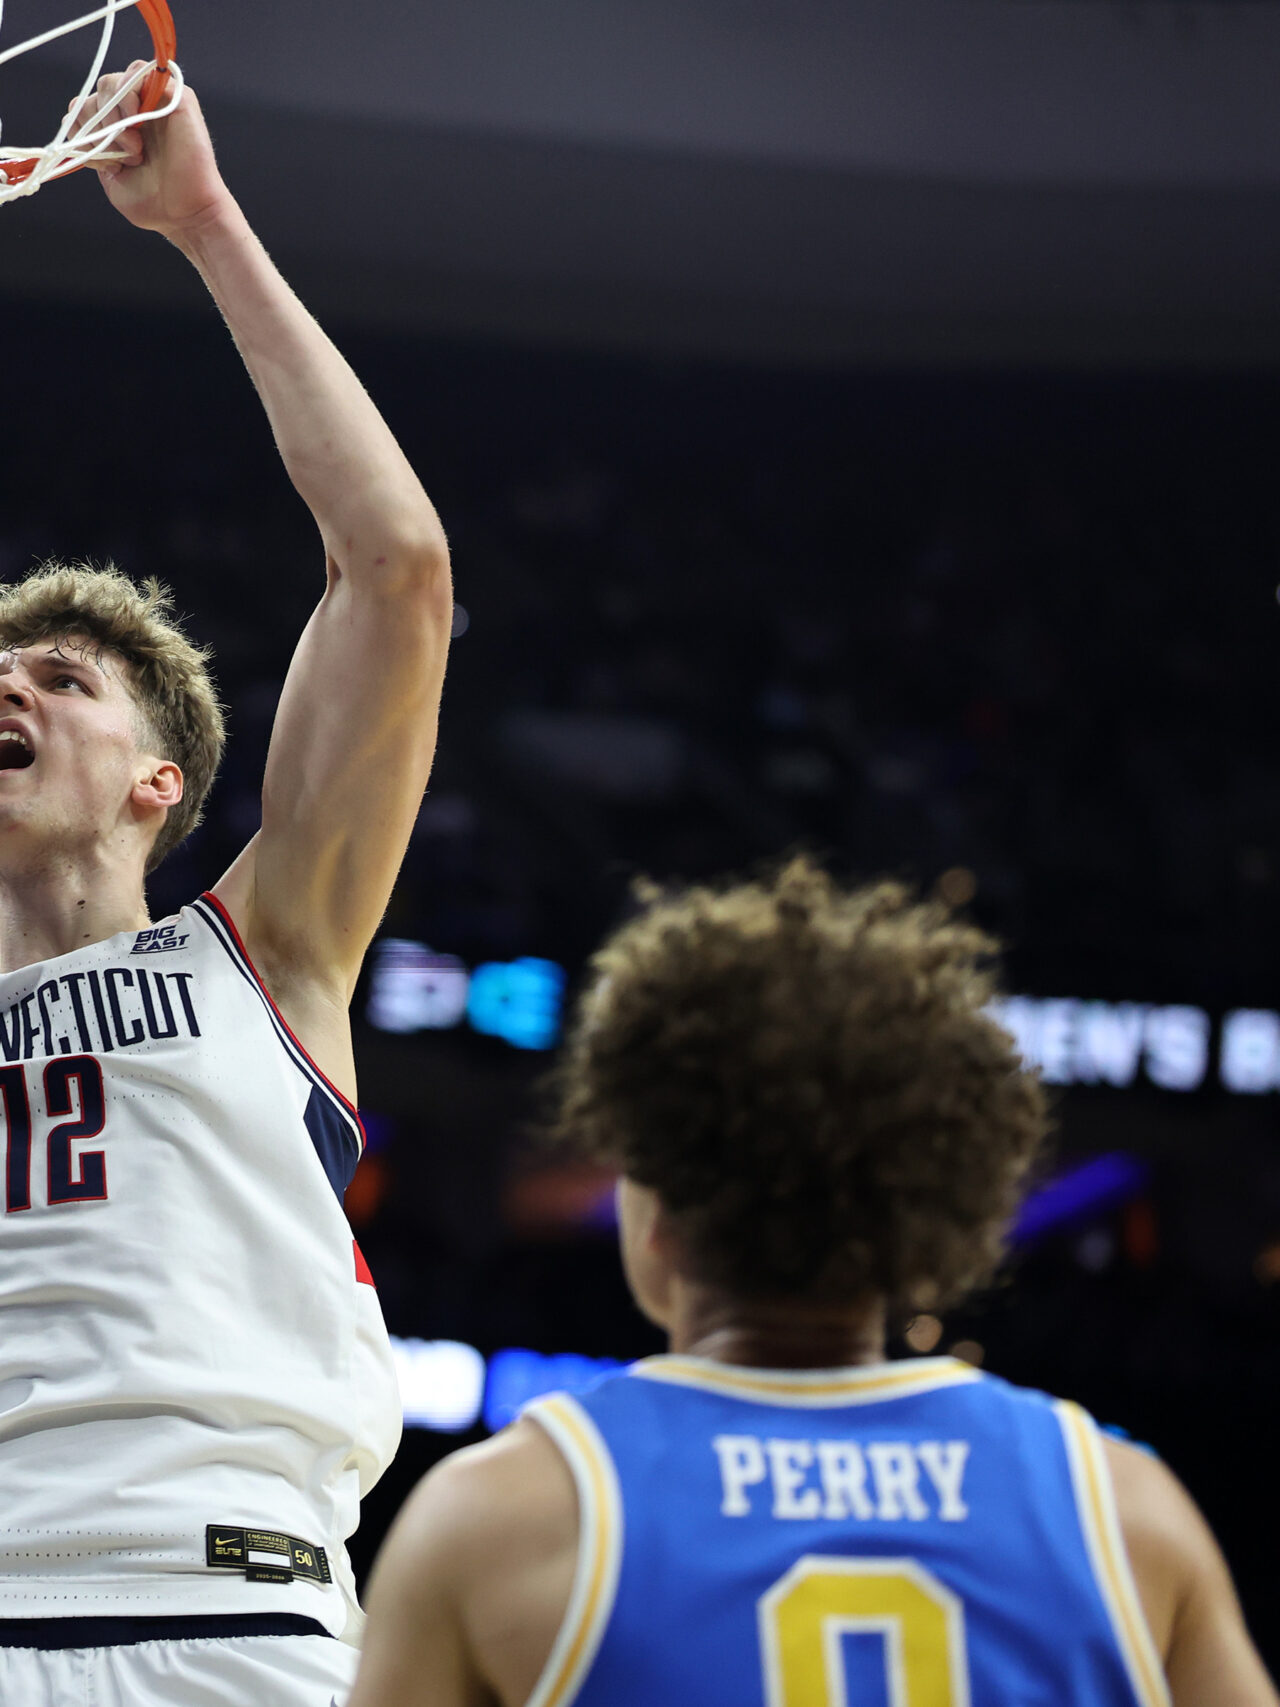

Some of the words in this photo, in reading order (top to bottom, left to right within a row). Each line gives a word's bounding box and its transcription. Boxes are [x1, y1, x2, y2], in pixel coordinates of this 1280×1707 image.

[131, 933, 190, 951] EAST
[135, 924, 177, 943] BIG
[712, 1433, 970, 1522] PERRY
[294, 1550, 313, 1567] 50
